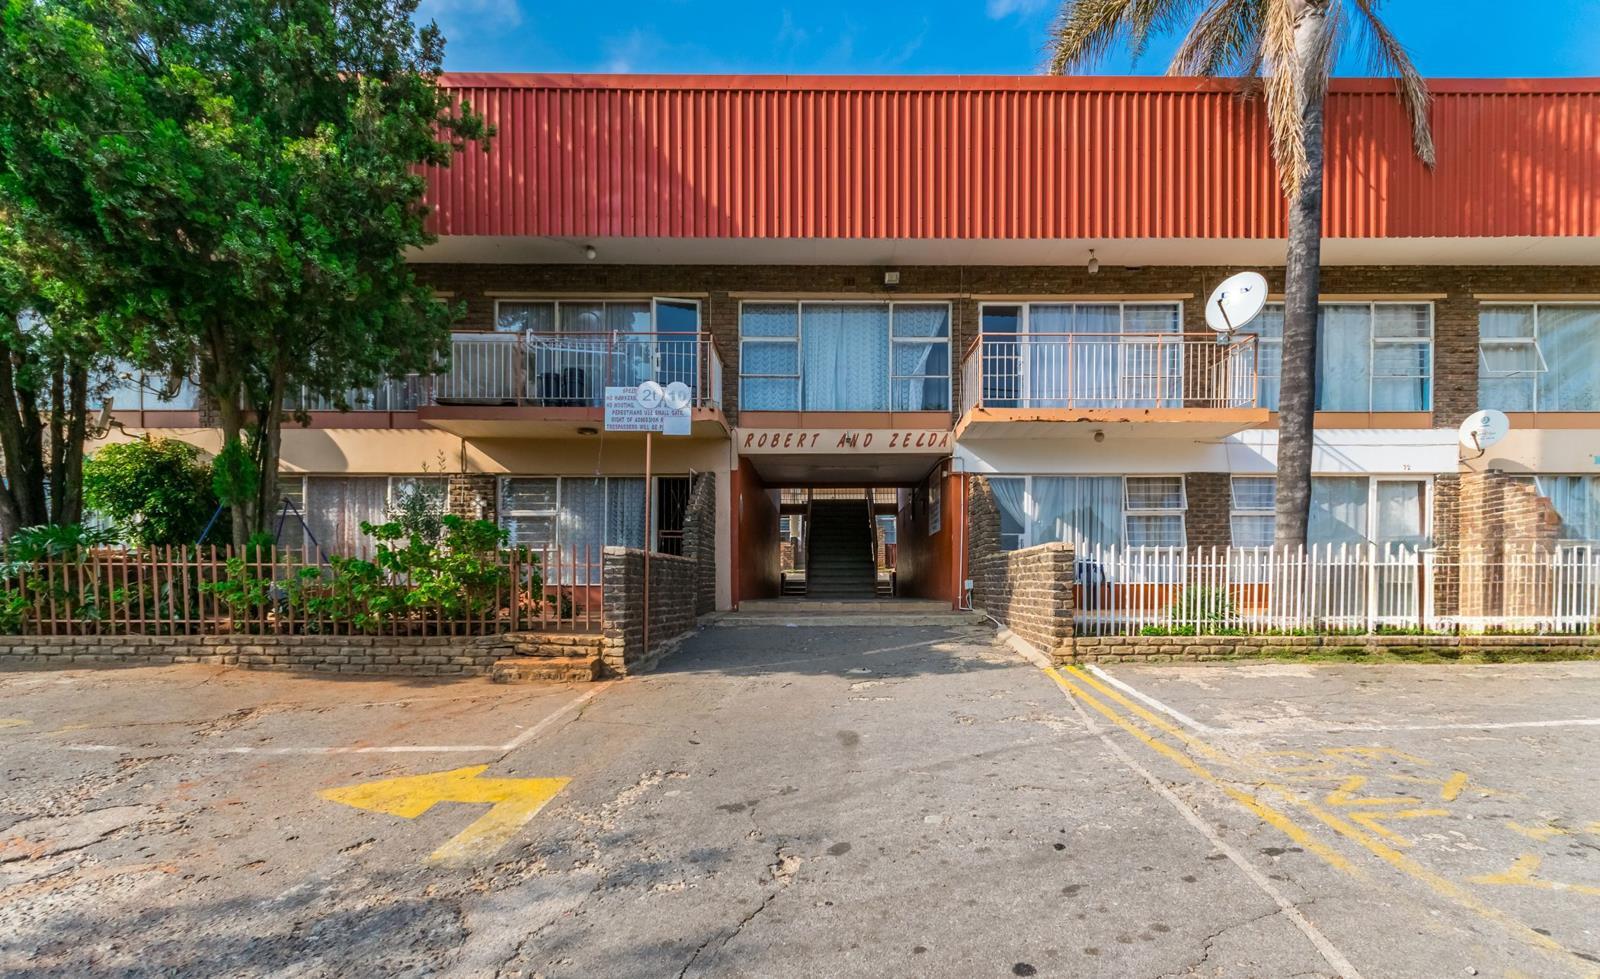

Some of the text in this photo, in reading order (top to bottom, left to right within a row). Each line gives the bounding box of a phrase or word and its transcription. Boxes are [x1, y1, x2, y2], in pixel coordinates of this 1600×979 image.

[744, 432, 949, 448] ROBERT AND ZELDA
